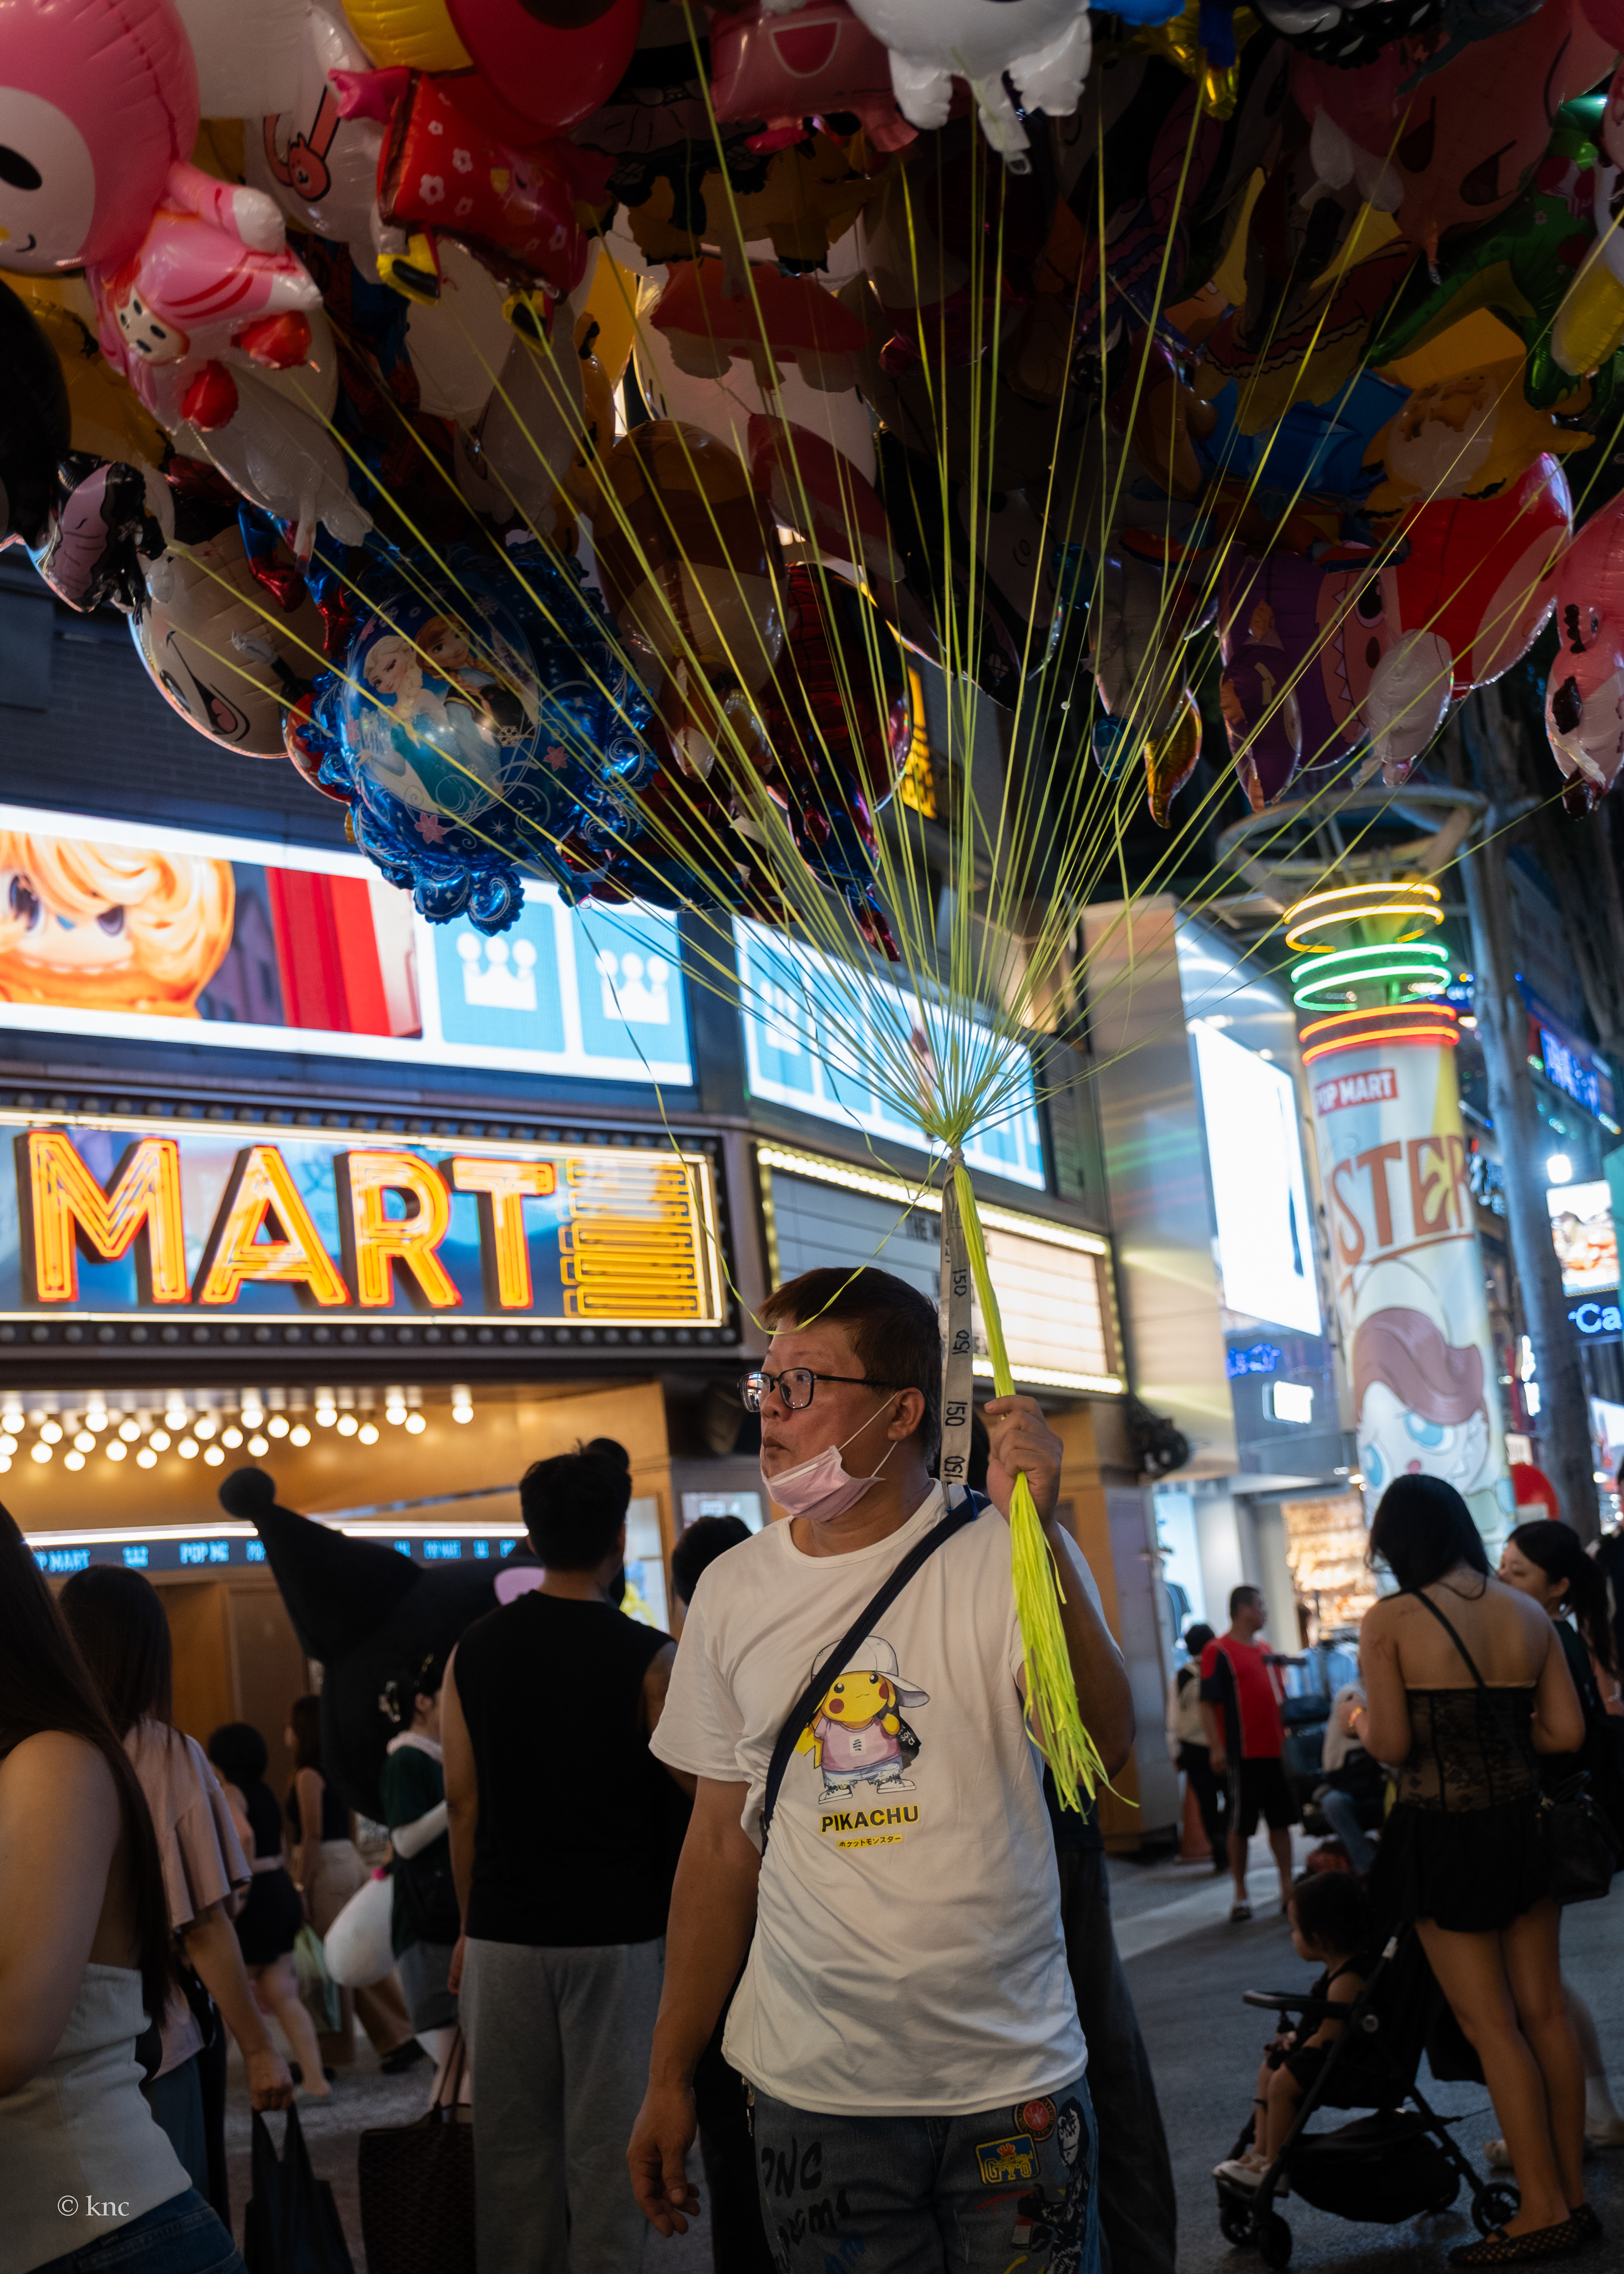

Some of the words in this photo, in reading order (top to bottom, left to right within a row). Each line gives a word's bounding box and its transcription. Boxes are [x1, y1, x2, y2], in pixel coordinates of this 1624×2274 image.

[1338, 1071, 1391, 1106] MART
[25, 1128, 556, 1310] MART
[952, 1269, 967, 1297] 150
[952, 1329, 971, 1354] 150
[945, 1401, 968, 1426] 150
[944, 1456, 966, 1478] 150
[821, 1805, 919, 1832] PIKACHU
